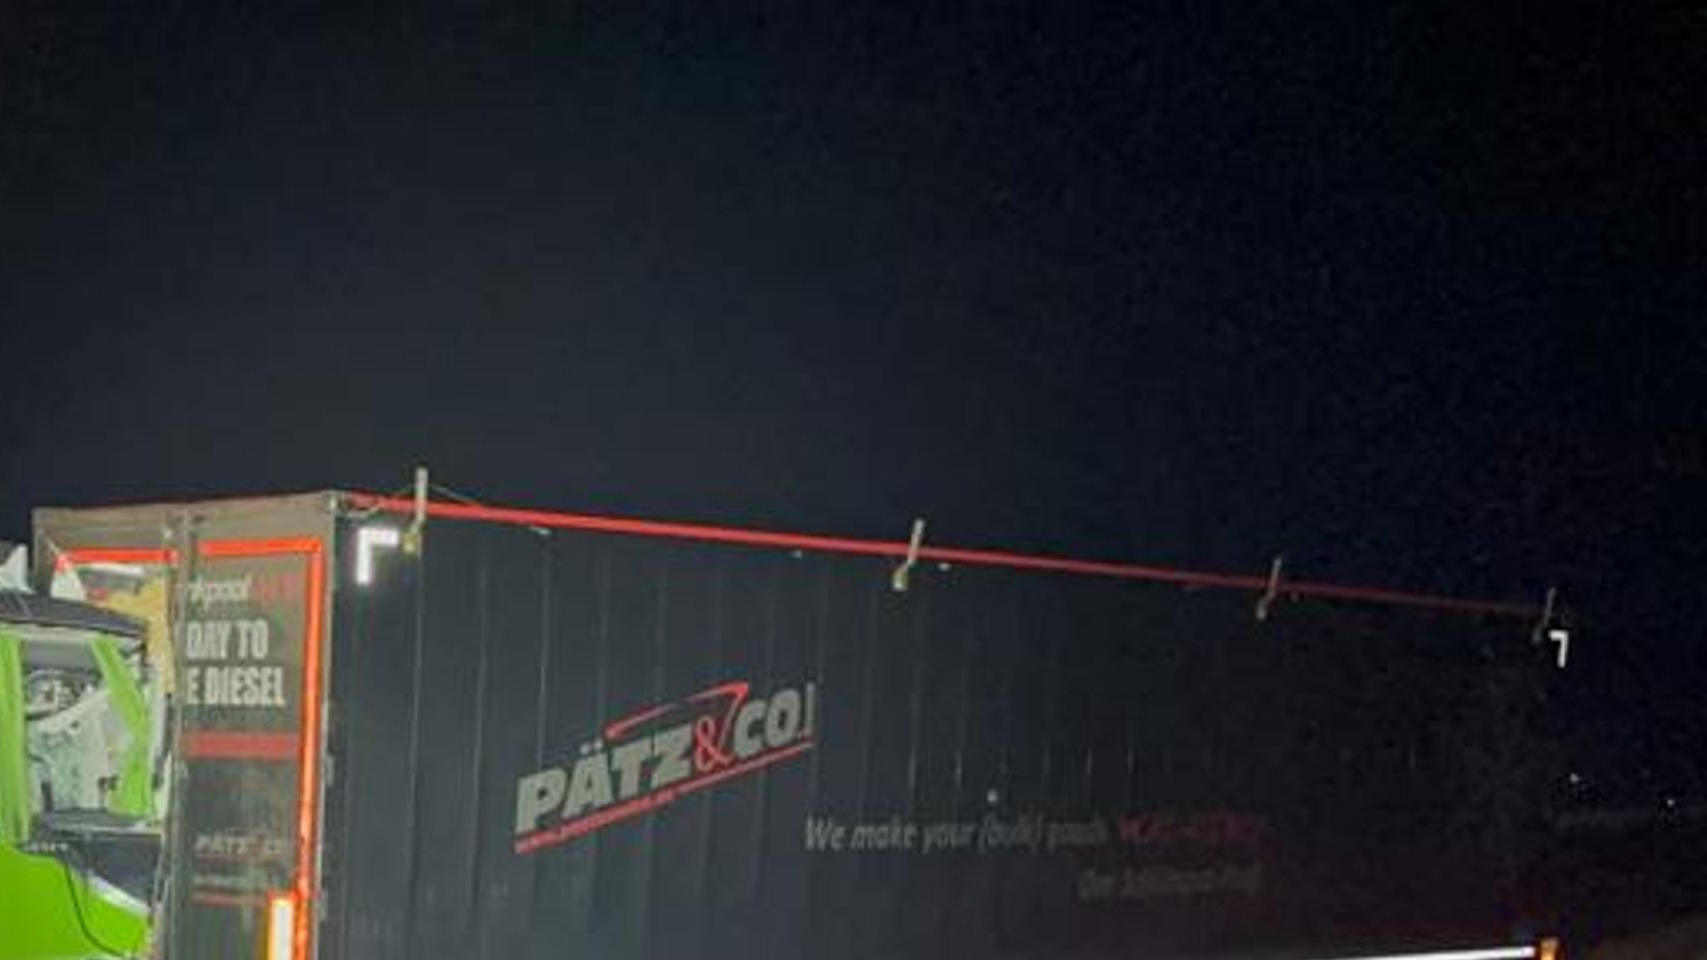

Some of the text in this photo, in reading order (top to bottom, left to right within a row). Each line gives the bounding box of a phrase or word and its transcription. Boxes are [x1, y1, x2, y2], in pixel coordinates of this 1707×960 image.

[186, 617, 270, 660] DAY TO
[204, 666, 286, 706] DIESEL
[804, 815, 846, 851] We
[850, 814, 919, 849] make
[922, 822, 975, 854] your
